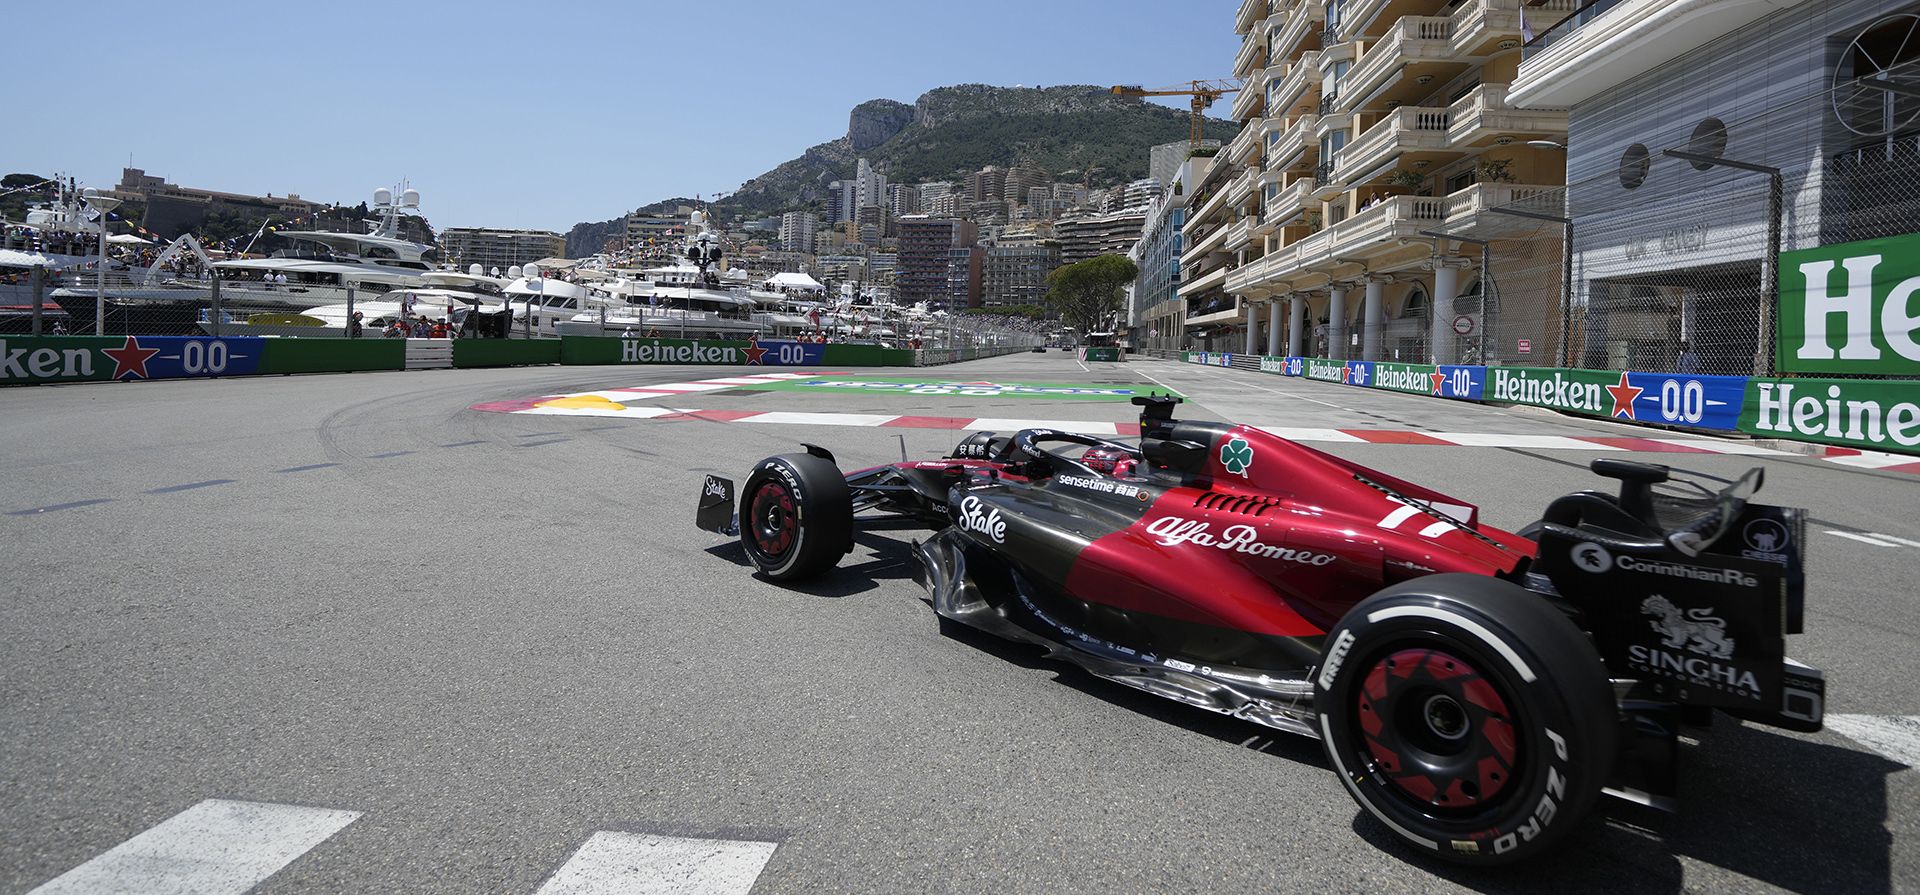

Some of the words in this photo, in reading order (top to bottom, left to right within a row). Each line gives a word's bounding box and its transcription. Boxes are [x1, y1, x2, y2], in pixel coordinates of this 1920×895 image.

[1796, 254, 1920, 362] He
[183, 339, 228, 374] 0.0
[621, 339, 738, 363] Heineken
[779, 343, 804, 364] 0.0
[1308, 360, 1341, 382] Heineken
[1353, 364, 1365, 385] 0.0
[1375, 363, 1429, 392] Heineken
[1452, 368, 1471, 397] 0.0
[1493, 369, 1604, 412] Heineken
[1661, 378, 1704, 424] 0.0
[1755, 382, 1920, 447] Heine
[704, 475, 727, 500] Stake
[765, 461, 776, 470] P
[774, 464, 803, 501] ZERO
[1058, 474, 1114, 493] sensetime
[958, 495, 1008, 544] Stake
[1146, 516, 1218, 547] Alfa
[1216, 524, 1337, 567] Romeo
[1615, 554, 1760, 588] CorinthianRe
[1318, 628, 1357, 692] PIRELLI
[1628, 644, 1761, 693] SINGHA
[1544, 727, 1569, 762] P
[1493, 765, 1568, 855] ZERO
